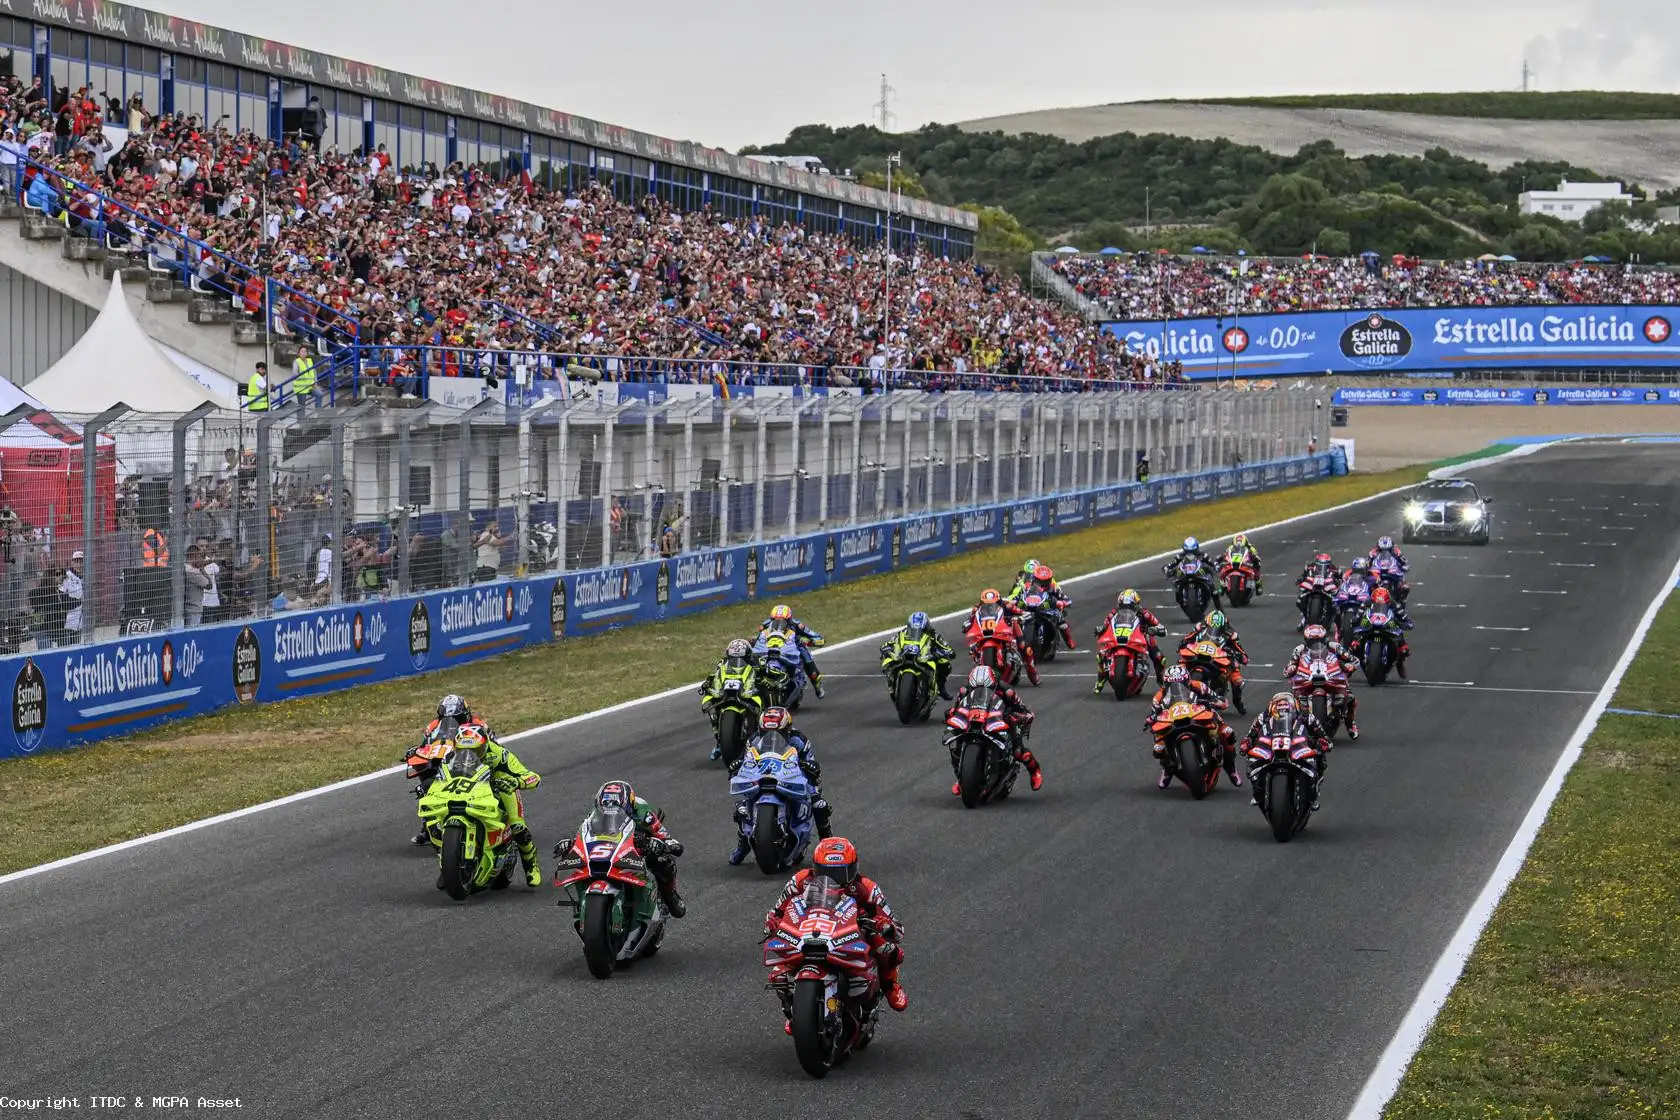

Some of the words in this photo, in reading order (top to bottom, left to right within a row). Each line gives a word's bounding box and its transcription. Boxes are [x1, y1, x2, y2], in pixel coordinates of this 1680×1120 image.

[1351, 328, 1401, 342] Estrella
[1432, 318, 1536, 344] Estrella
[1540, 315, 1635, 342] Galicia
[1124, 328, 1215, 358] Galicia
[1270, 325, 1300, 349] 0,0
[1353, 341, 1399, 356] Galicia
[441, 594, 473, 633] Estrella
[474, 587, 503, 626] Galicia
[274, 620, 314, 664] Estrella
[315, 612, 351, 657] Galicia
[64, 652, 114, 702] Estrella
[115, 642, 159, 692] Galicia
[17, 682, 42, 705] Estrella
[18, 704, 41, 727] Galicia
[1172, 704, 1190, 717] 23
[441, 778, 477, 794] 49
[776, 929, 800, 945] Lenovo
[832, 932, 860, 947] Lenovo
